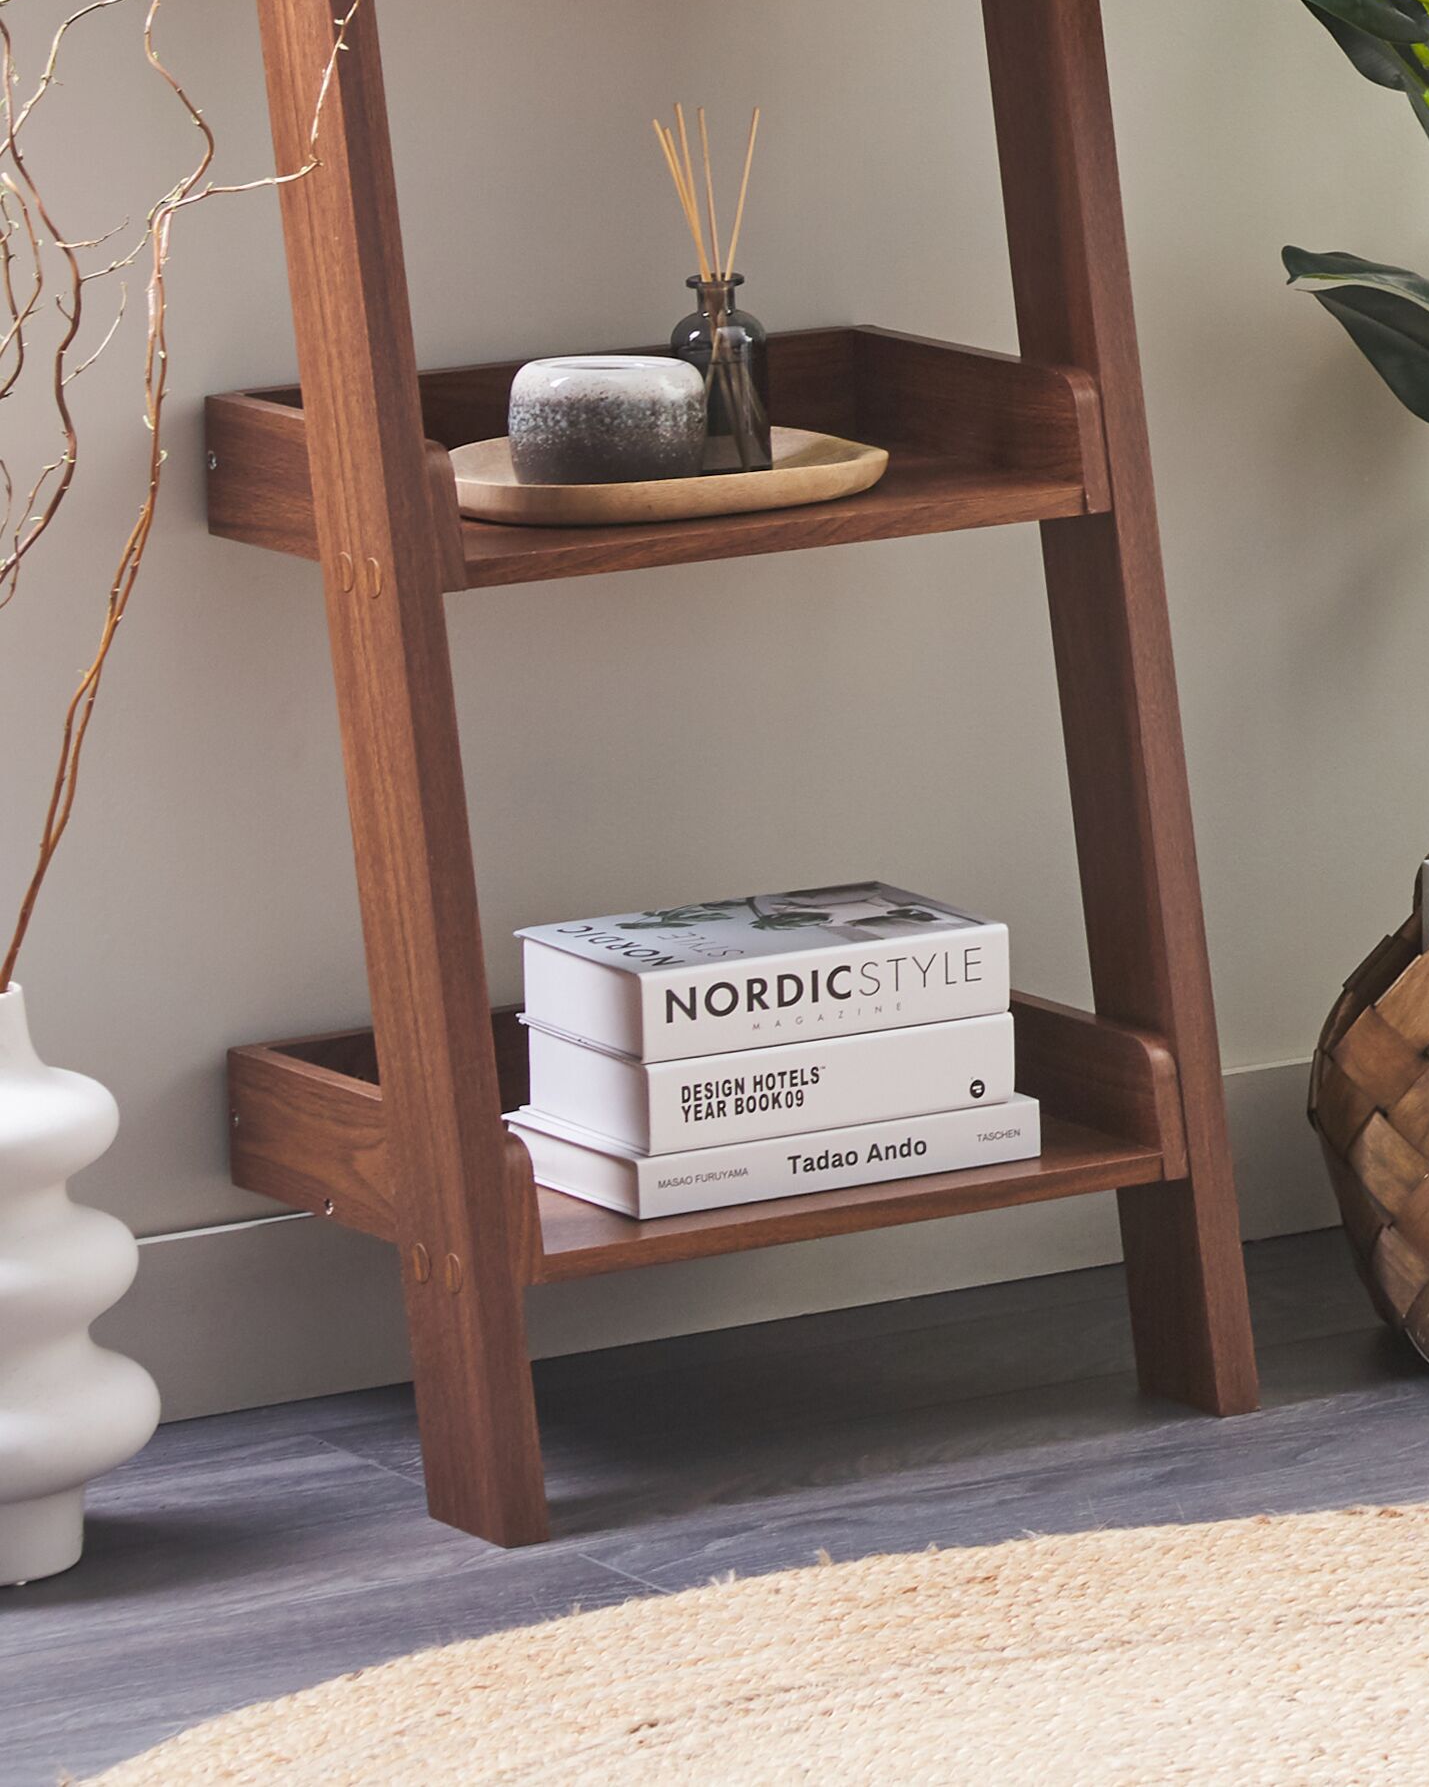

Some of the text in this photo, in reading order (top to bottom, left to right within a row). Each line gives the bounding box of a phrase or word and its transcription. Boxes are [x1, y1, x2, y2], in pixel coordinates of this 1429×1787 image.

[556, 925, 685, 967] NORDIC
[752, 1002, 903, 1031] MAGAZINE
[681, 1077, 746, 1105] DESIGN
[681, 1097, 728, 1124] YEAR
[976, 1127, 1021, 1144] TASCHEN
[788, 1137, 928, 1176] Tadao Ando
[657, 1166, 749, 1190] MASAO FURUYAMA
